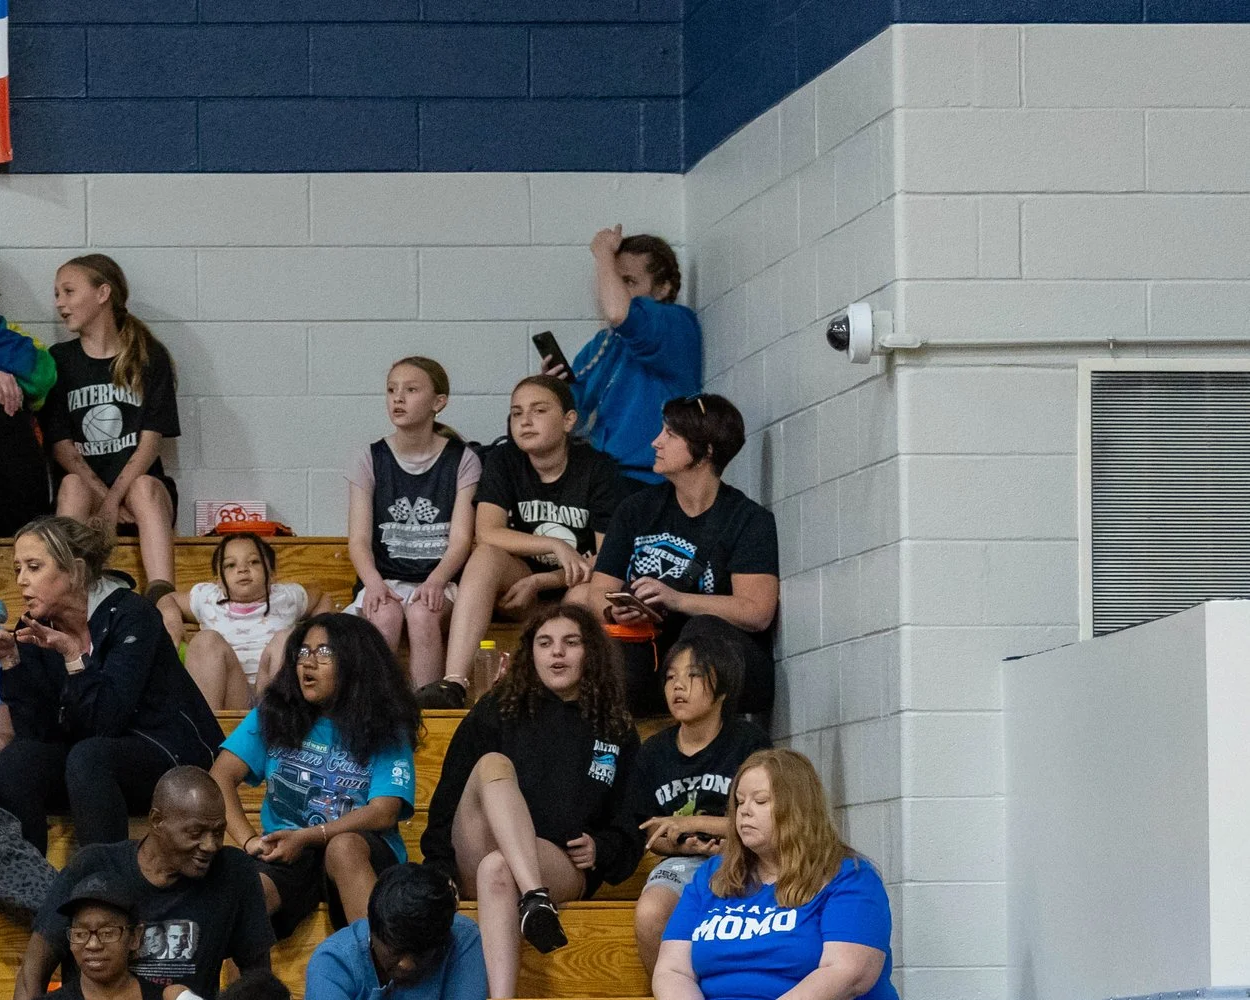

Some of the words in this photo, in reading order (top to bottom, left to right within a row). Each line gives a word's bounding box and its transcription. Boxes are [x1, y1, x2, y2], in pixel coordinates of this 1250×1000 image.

[593, 739, 620, 756] DAYTO
[590, 760, 616, 779] BEAC
[334, 776, 370, 790] 2020
[692, 909, 798, 941] MOMO
